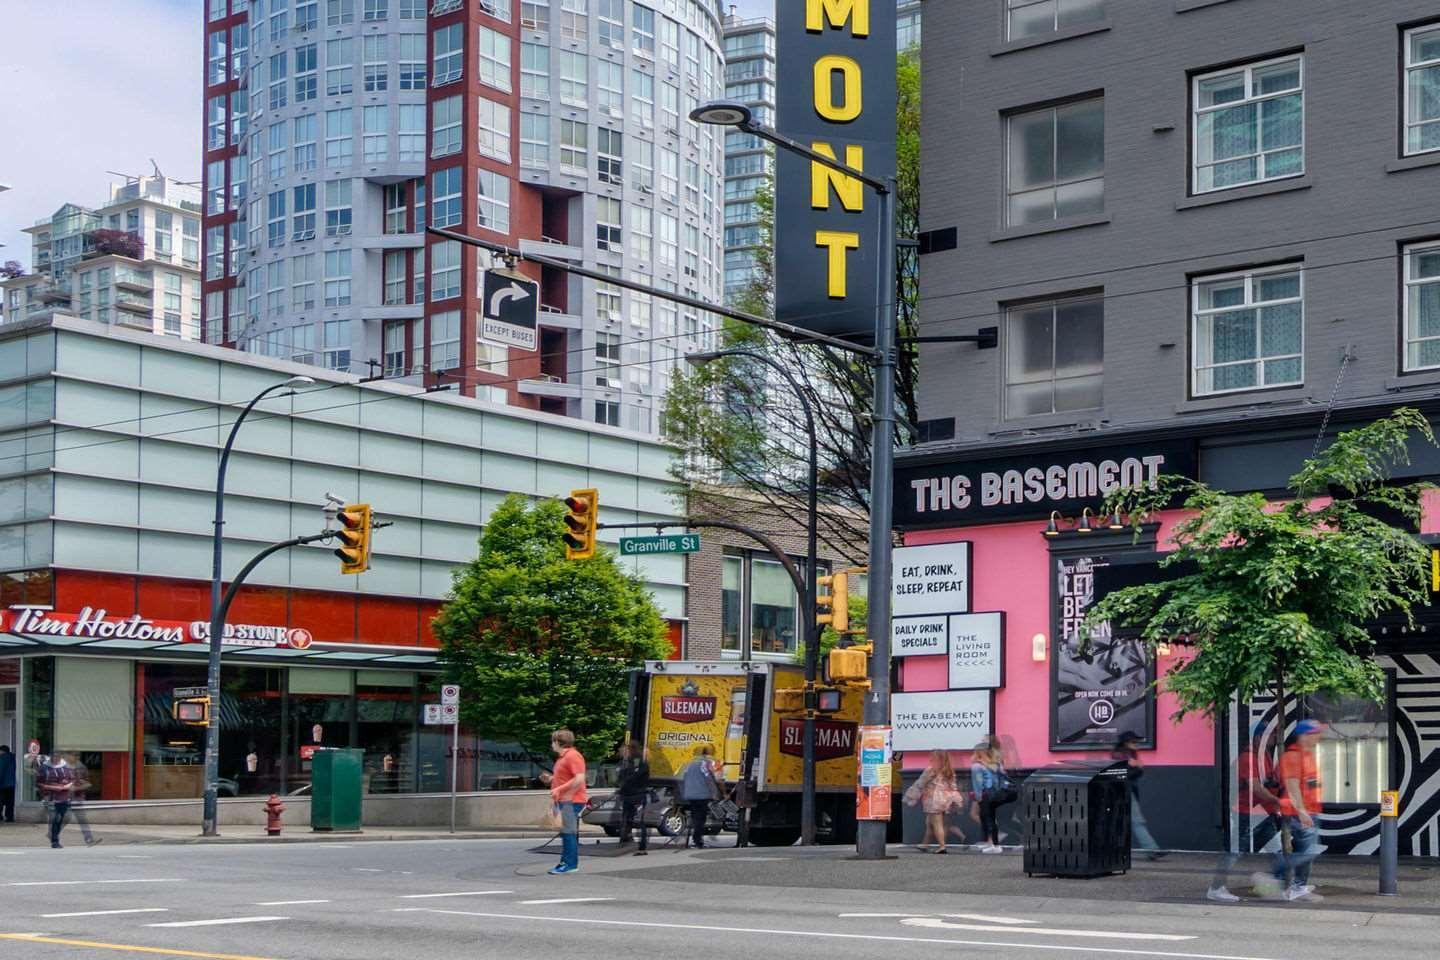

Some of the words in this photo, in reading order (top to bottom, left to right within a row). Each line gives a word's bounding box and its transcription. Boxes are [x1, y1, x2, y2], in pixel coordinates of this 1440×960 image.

[485, 323, 509, 337] EXCEPT
[511, 330, 533, 342] BUSES
[911, 475, 971, 512] THE
[981, 455, 1165, 507] BASEMENT
[625, 539, 677, 552] Granville
[681, 537, 695, 549] St
[902, 566, 922, 578] EAT,
[924, 564, 957, 577] DRINK,
[896, 583, 925, 595] SLEEP,
[927, 580, 963, 593] REPEAT
[1064, 596, 1085, 618] BE
[9, 605, 71, 636] Tim
[74, 606, 184, 642] Hortons
[895, 626, 917, 635] DAILY
[919, 624, 944, 634] DRINK
[191, 621, 235, 641] CD
[236, 624, 287, 644] STONE
[901, 637, 938, 648] SPECIALS
[956, 651, 987, 659] ROOM
[664, 701, 713, 715] SLEEMAN
[922, 711, 984, 720] BASEMENT
[658, 733, 714, 742] ORIGINAL
[784, 726, 852, 748] SLMAN
